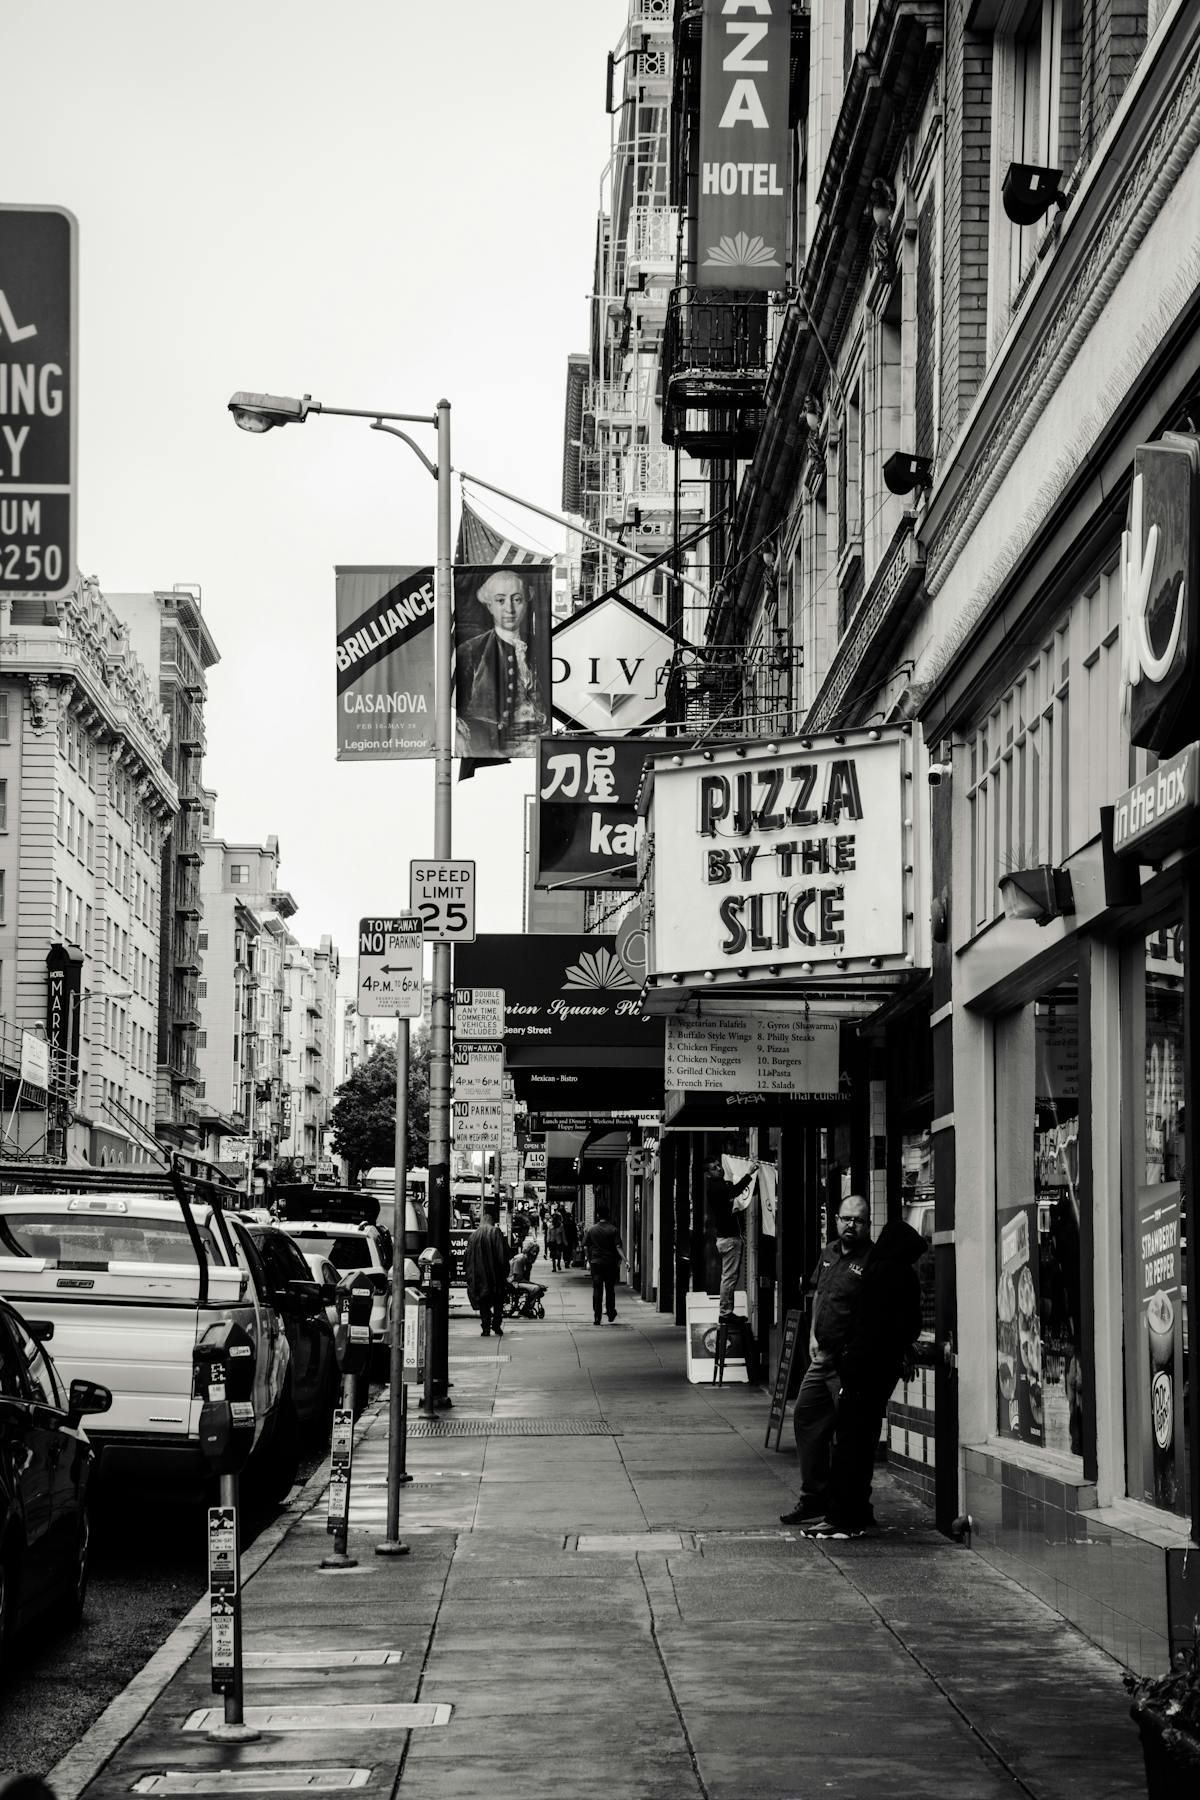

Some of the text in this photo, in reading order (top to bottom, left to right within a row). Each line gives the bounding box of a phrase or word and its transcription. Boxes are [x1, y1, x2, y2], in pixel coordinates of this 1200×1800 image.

[702, 162, 783, 195] HOTEL
[1, 500, 41, 535] UM
[336, 583, 435, 672] BRILLIANCE
[345, 737, 428, 751] Legion of Honor
[540, 746, 619, 804] 刀屋
[696, 759, 864, 838] PIZZA
[1115, 764, 1186, 844] in the box
[703, 834, 857, 886] BY THE
[415, 870, 471, 882] SPEED
[422, 886, 464, 899] LIMIT
[417, 903, 468, 932] 25
[718, 885, 846, 955] SLICE
[368, 919, 418, 932] TOW-AWAY
[360, 933, 421, 953] NO PARKING
[50, 970, 64, 978] HOTEL
[457, 989, 471, 1003] NO
[504, 1003, 542, 1015] nion
[547, 1000, 610, 1021] Square
[527, 1026, 552, 1034] Street
[678, 1021, 717, 1030] Vegetarian
[719, 1020, 747, 1029] Falafels
[767, 1022, 790, 1031] Gyros
[677, 1031, 705, 1039] Buffalo
[707, 1031, 726, 1041] Style
[728, 1032, 752, 1042] Wings
[767, 1033, 789, 1042] Philly
[791, 1033, 815, 1041] Steaks
[677, 1043, 708, 1051] Chicken
[710, 1043, 738, 1053] Fingers
[757, 1045, 790, 1053] 9. Pizzas
[454, 1052, 500, 1064] NO PARKING
[667, 1055, 741, 1066] 4. Chicken Nuggets
[757, 1057, 802, 1067] 10. Burgers
[667, 1066, 736, 1076] 5. Grilled Chicken
[771, 1069, 791, 1077] Pasta
[666, 1079, 723, 1088] 6. French Fries
[757, 1081, 796, 1089] 12. Salads
[454, 1103, 468, 1116] NO
[471, 1105, 501, 1116] PARKING
[451, 1238, 469, 1247] vale
[1141, 1220, 1178, 1260] STRAWBERRY
[1145, 1253, 1175, 1288] DR PEPPER
